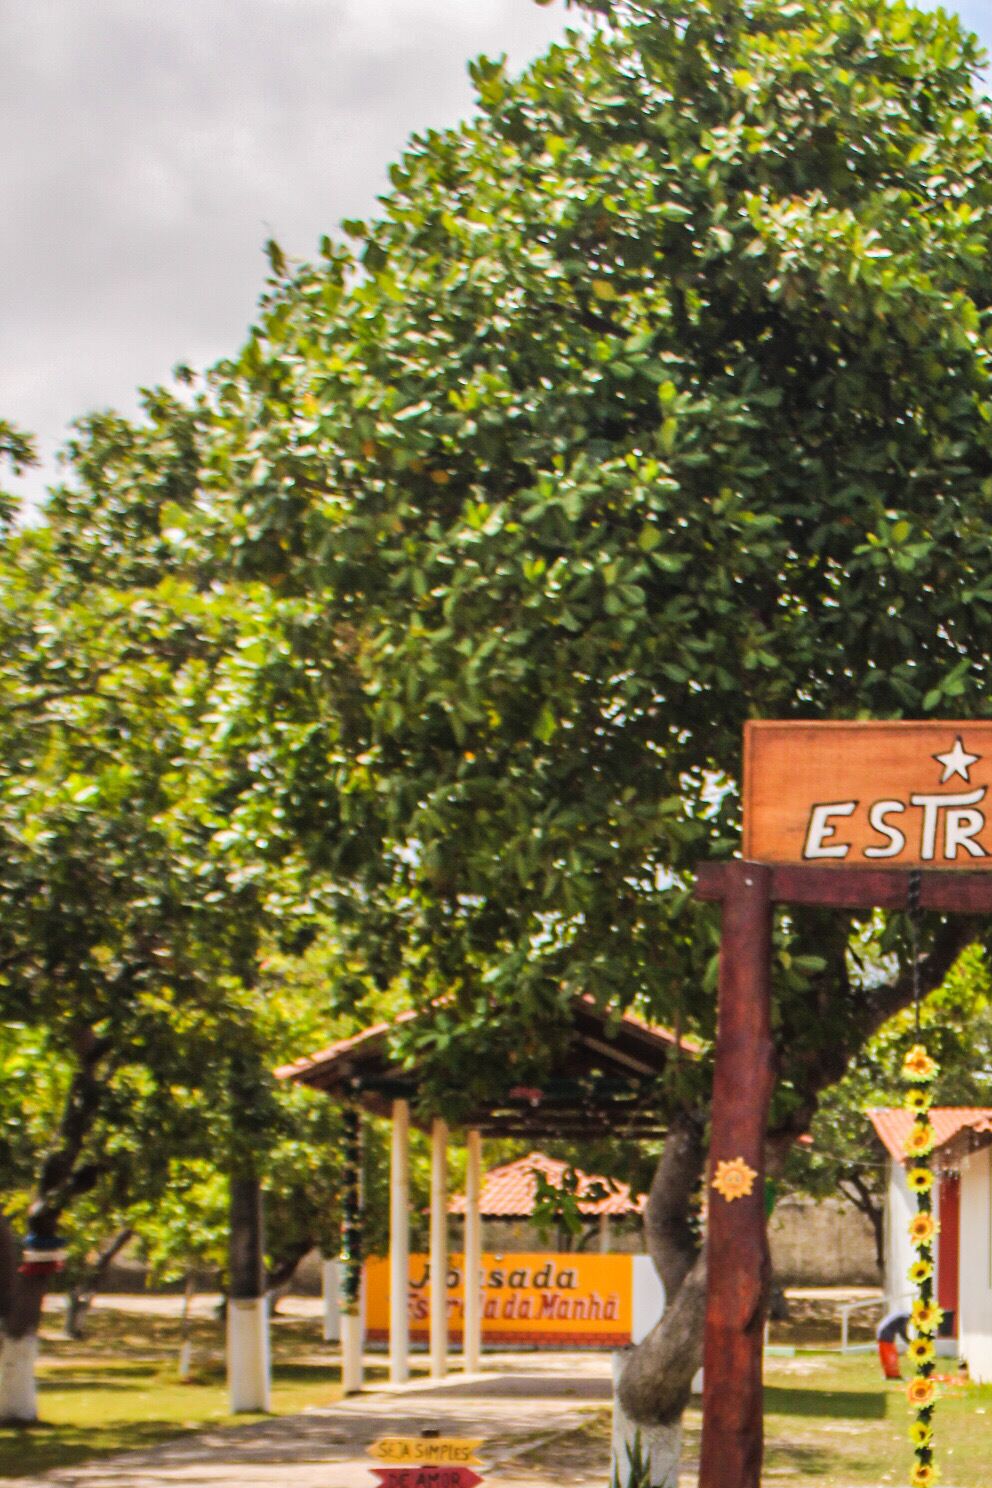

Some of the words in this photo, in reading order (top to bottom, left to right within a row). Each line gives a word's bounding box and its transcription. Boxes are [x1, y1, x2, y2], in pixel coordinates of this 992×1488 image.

[408, 1261, 577, 1289] osada
[503, 1293, 533, 1320] da
[415, 1443, 471, 1461] SIMPLES
[416, 1471, 461, 1488] AMOR
